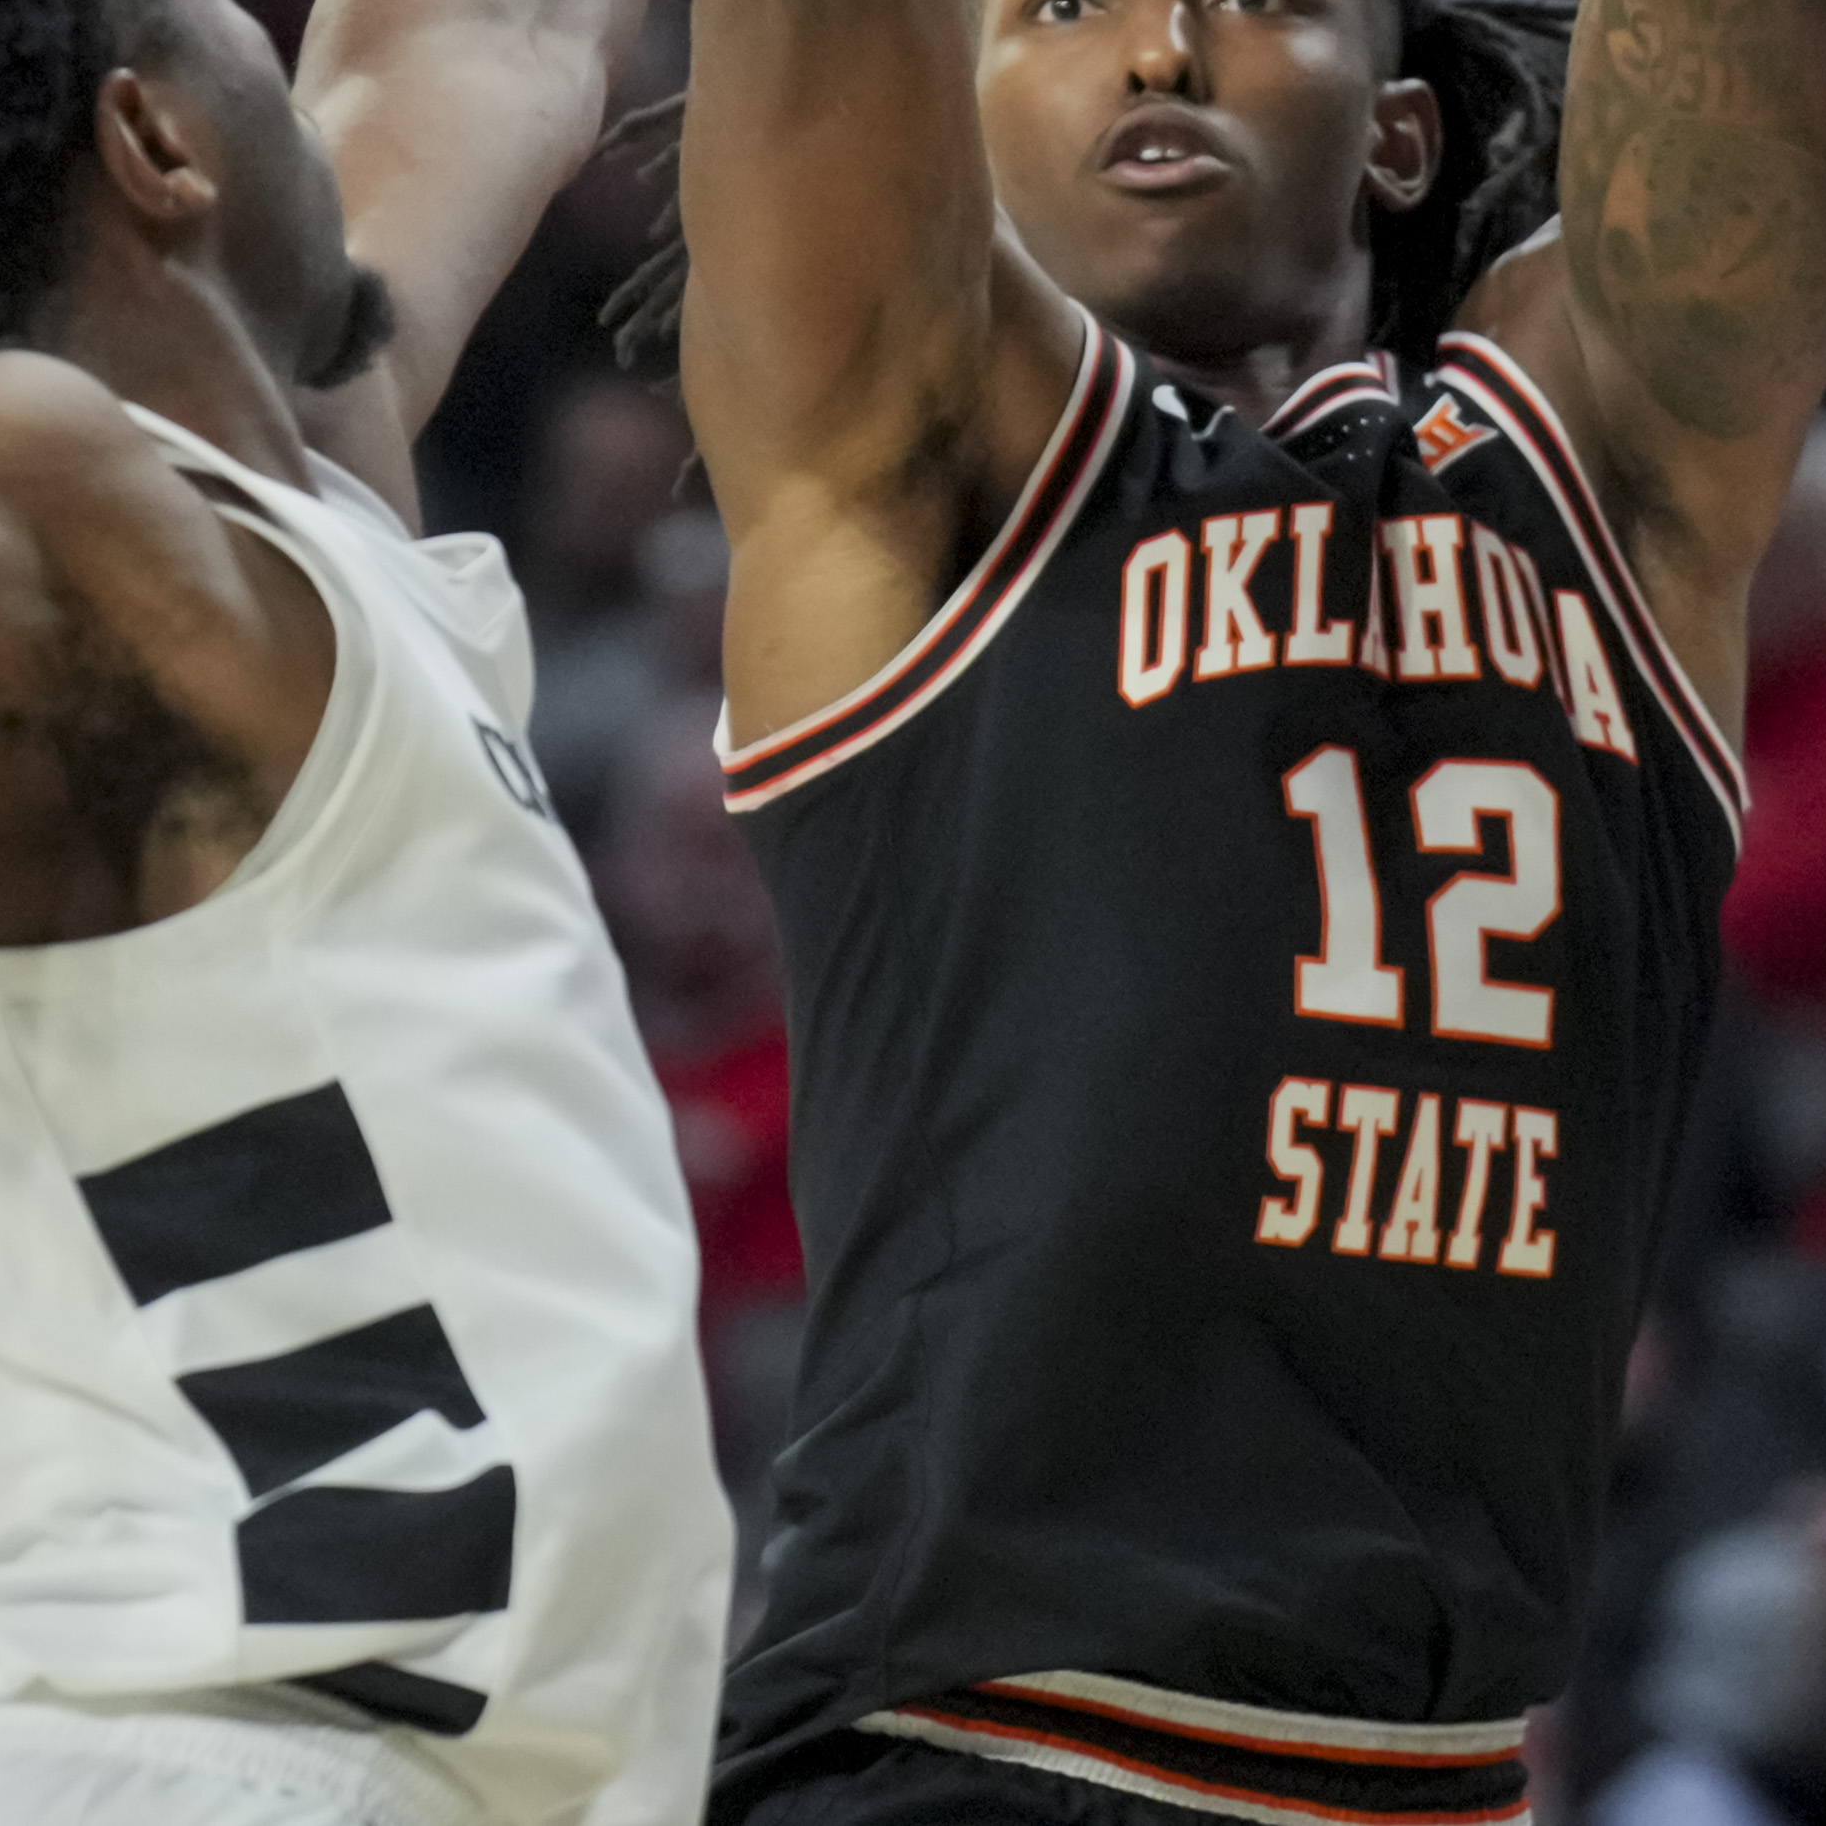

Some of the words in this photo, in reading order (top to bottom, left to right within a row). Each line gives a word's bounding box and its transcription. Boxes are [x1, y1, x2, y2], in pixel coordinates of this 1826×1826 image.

[1118, 502, 1639, 766] OKLHOA
[1282, 743, 1562, 1049] 12
[1254, 1075, 1558, 1277] STATE
